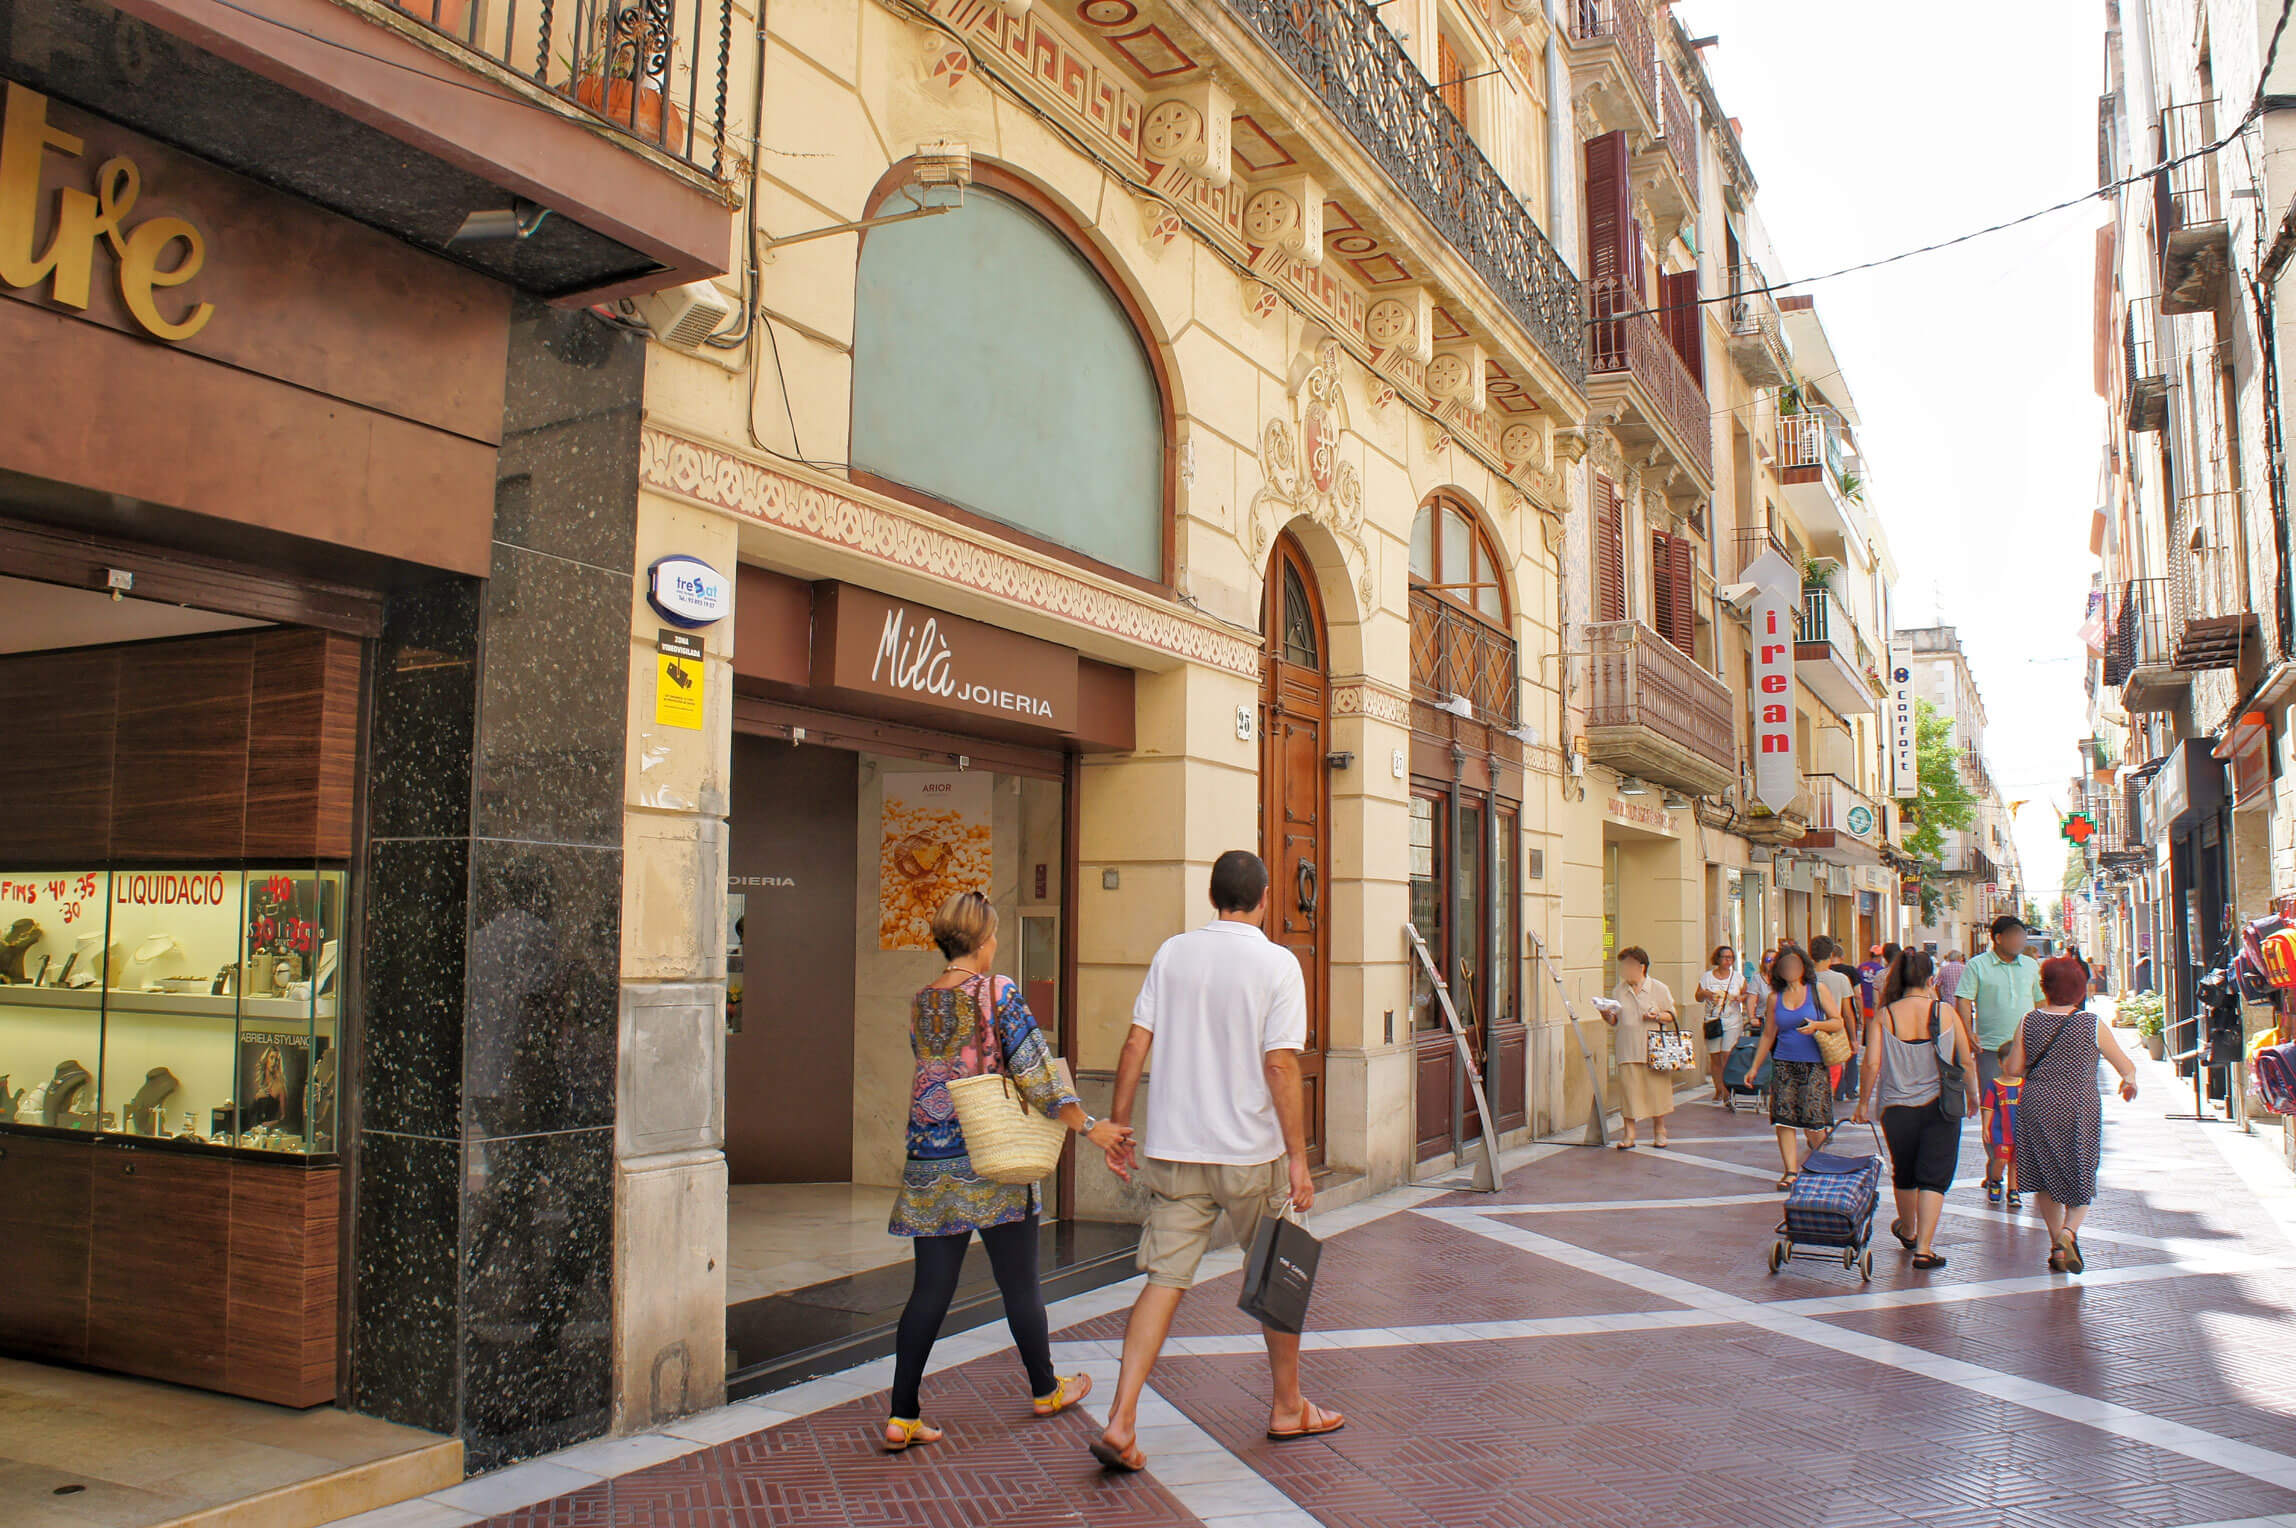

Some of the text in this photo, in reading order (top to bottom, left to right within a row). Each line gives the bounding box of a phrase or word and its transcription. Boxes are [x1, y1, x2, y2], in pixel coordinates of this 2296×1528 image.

[871, 607, 1053, 718] Milà JOIERIA
[1760, 610, 1789, 753] irean
[1238, 710, 1251, 734] 25
[921, 783, 952, 793] ARIOR
[117, 872, 225, 905] LIQUIDACIÓ
[728, 876, 796, 887] OIERIA
[240, 1032, 273, 1043] ABRIELA
